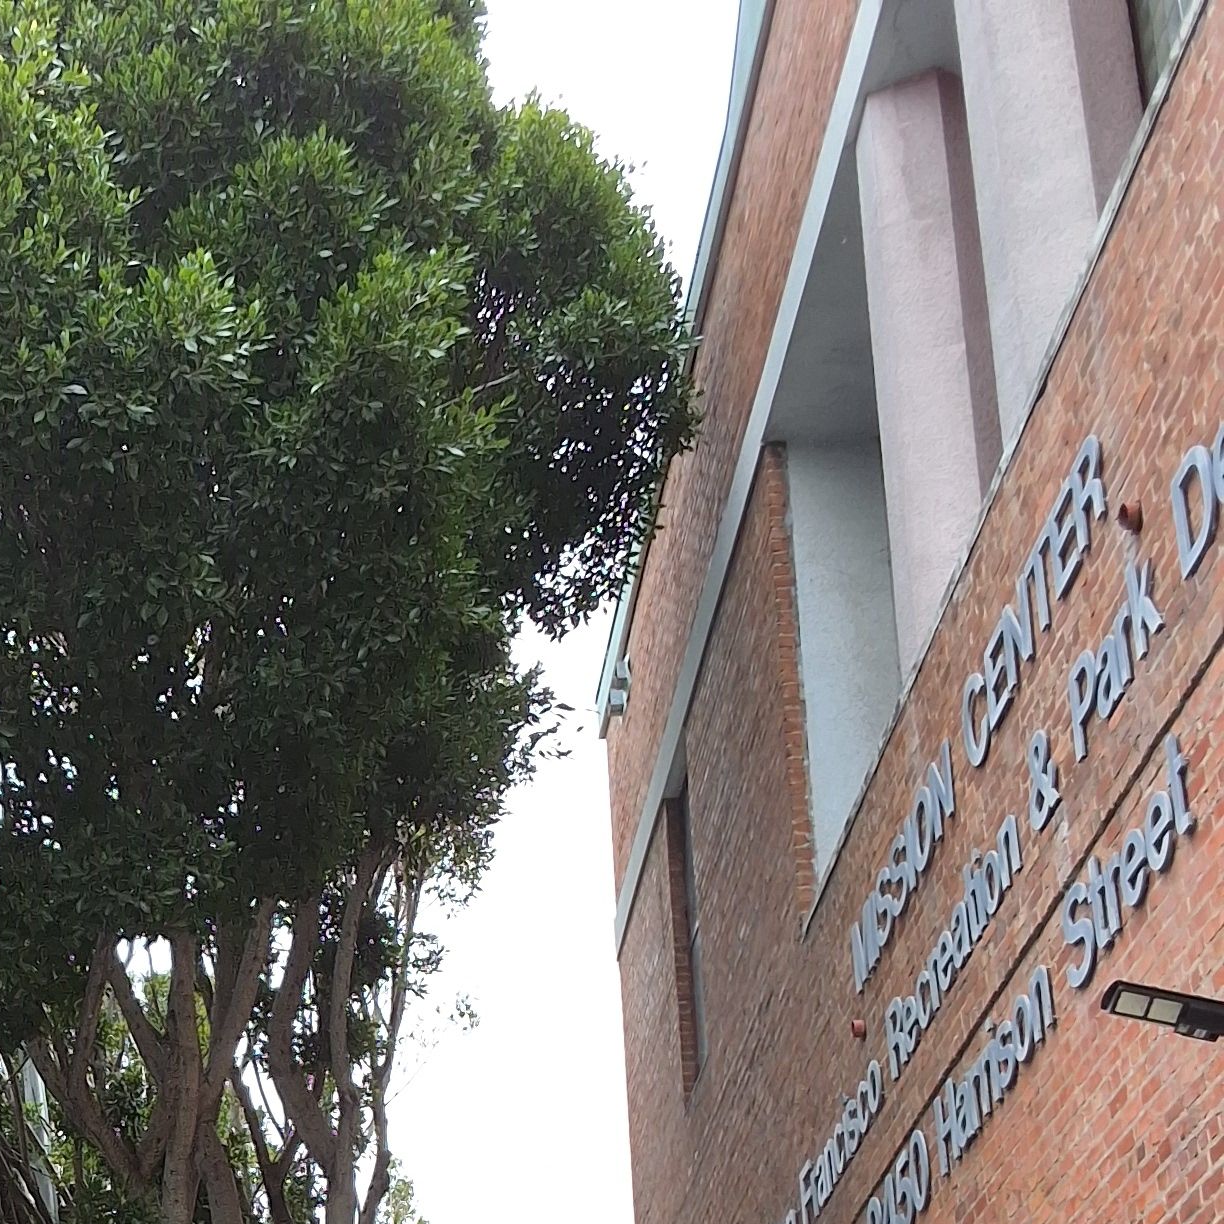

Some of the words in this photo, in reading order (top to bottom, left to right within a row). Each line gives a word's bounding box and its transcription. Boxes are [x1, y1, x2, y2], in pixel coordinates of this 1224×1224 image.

[851, 738, 955, 993] MISSION
[962, 434, 1106, 767] CENTER
[885, 814, 1024, 1081] Recreation
[1029, 729, 1061, 831] &
[1068, 557, 1165, 763] Park
[933, 964, 1057, 1178] Harrison
[1062, 732, 1196, 989] Street
